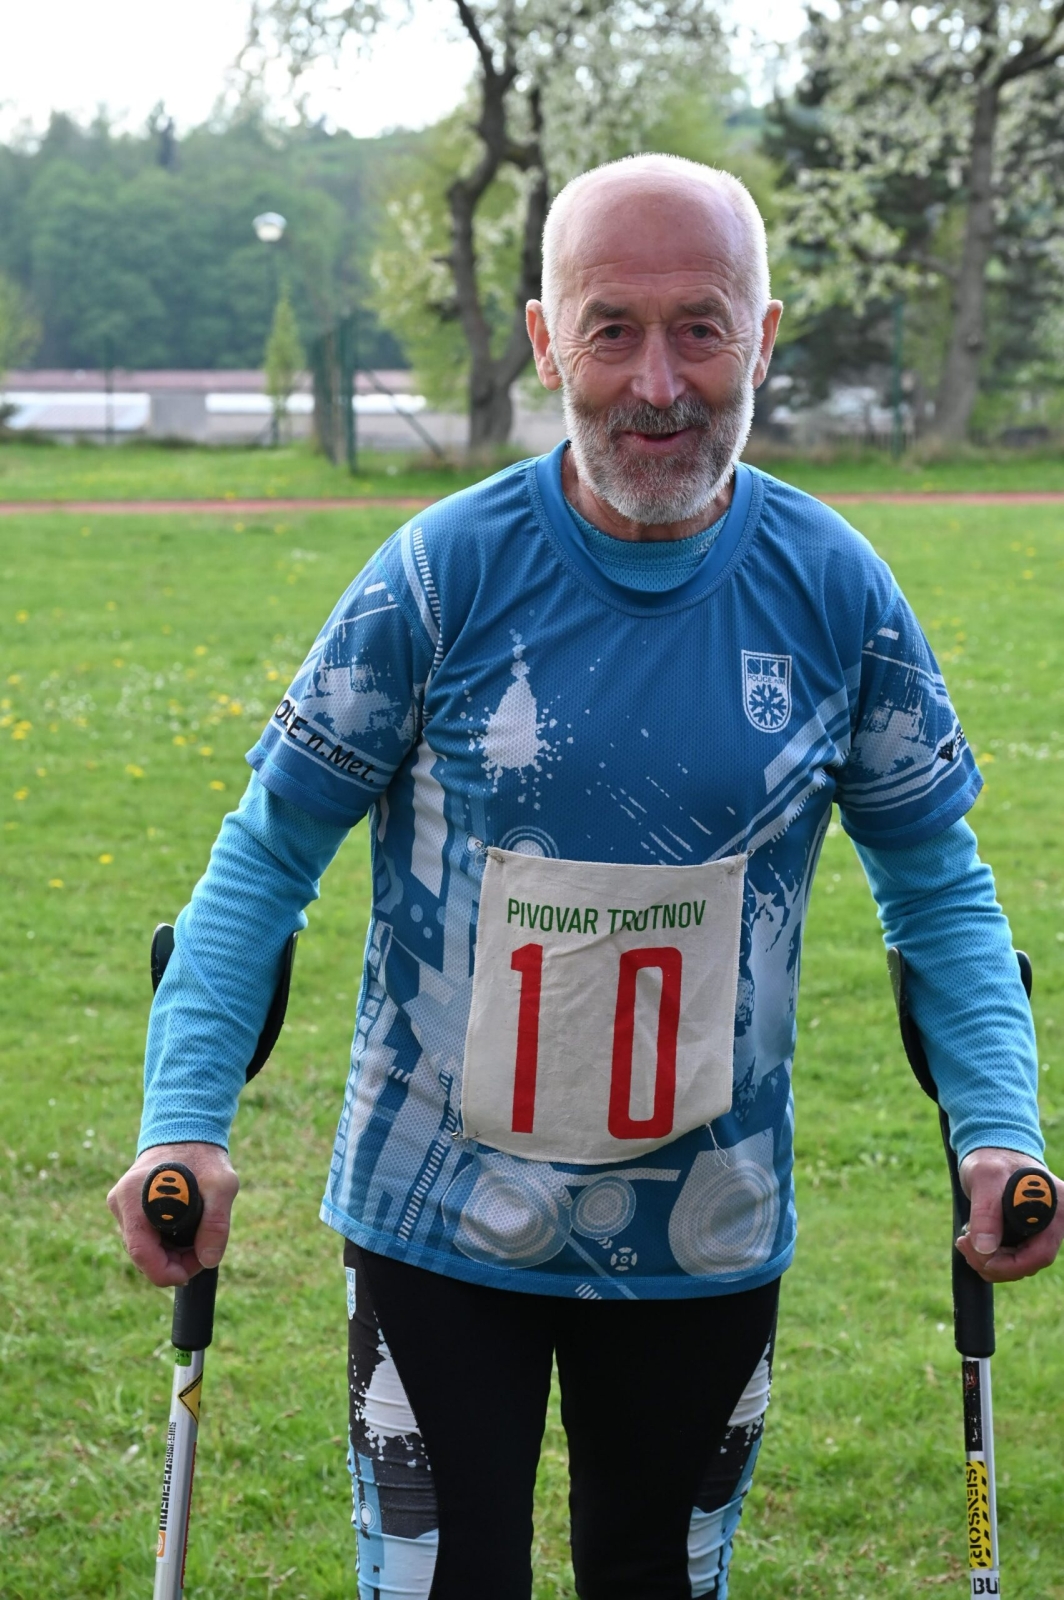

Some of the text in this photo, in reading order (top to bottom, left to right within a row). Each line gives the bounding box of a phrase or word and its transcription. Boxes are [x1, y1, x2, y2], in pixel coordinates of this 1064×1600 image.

[747, 658, 786, 679] SKI
[506, 897, 707, 935] PIVOVAR TRUTNOV
[510, 942, 683, 1140] 10
[966, 1467, 983, 1560] SENSOR
